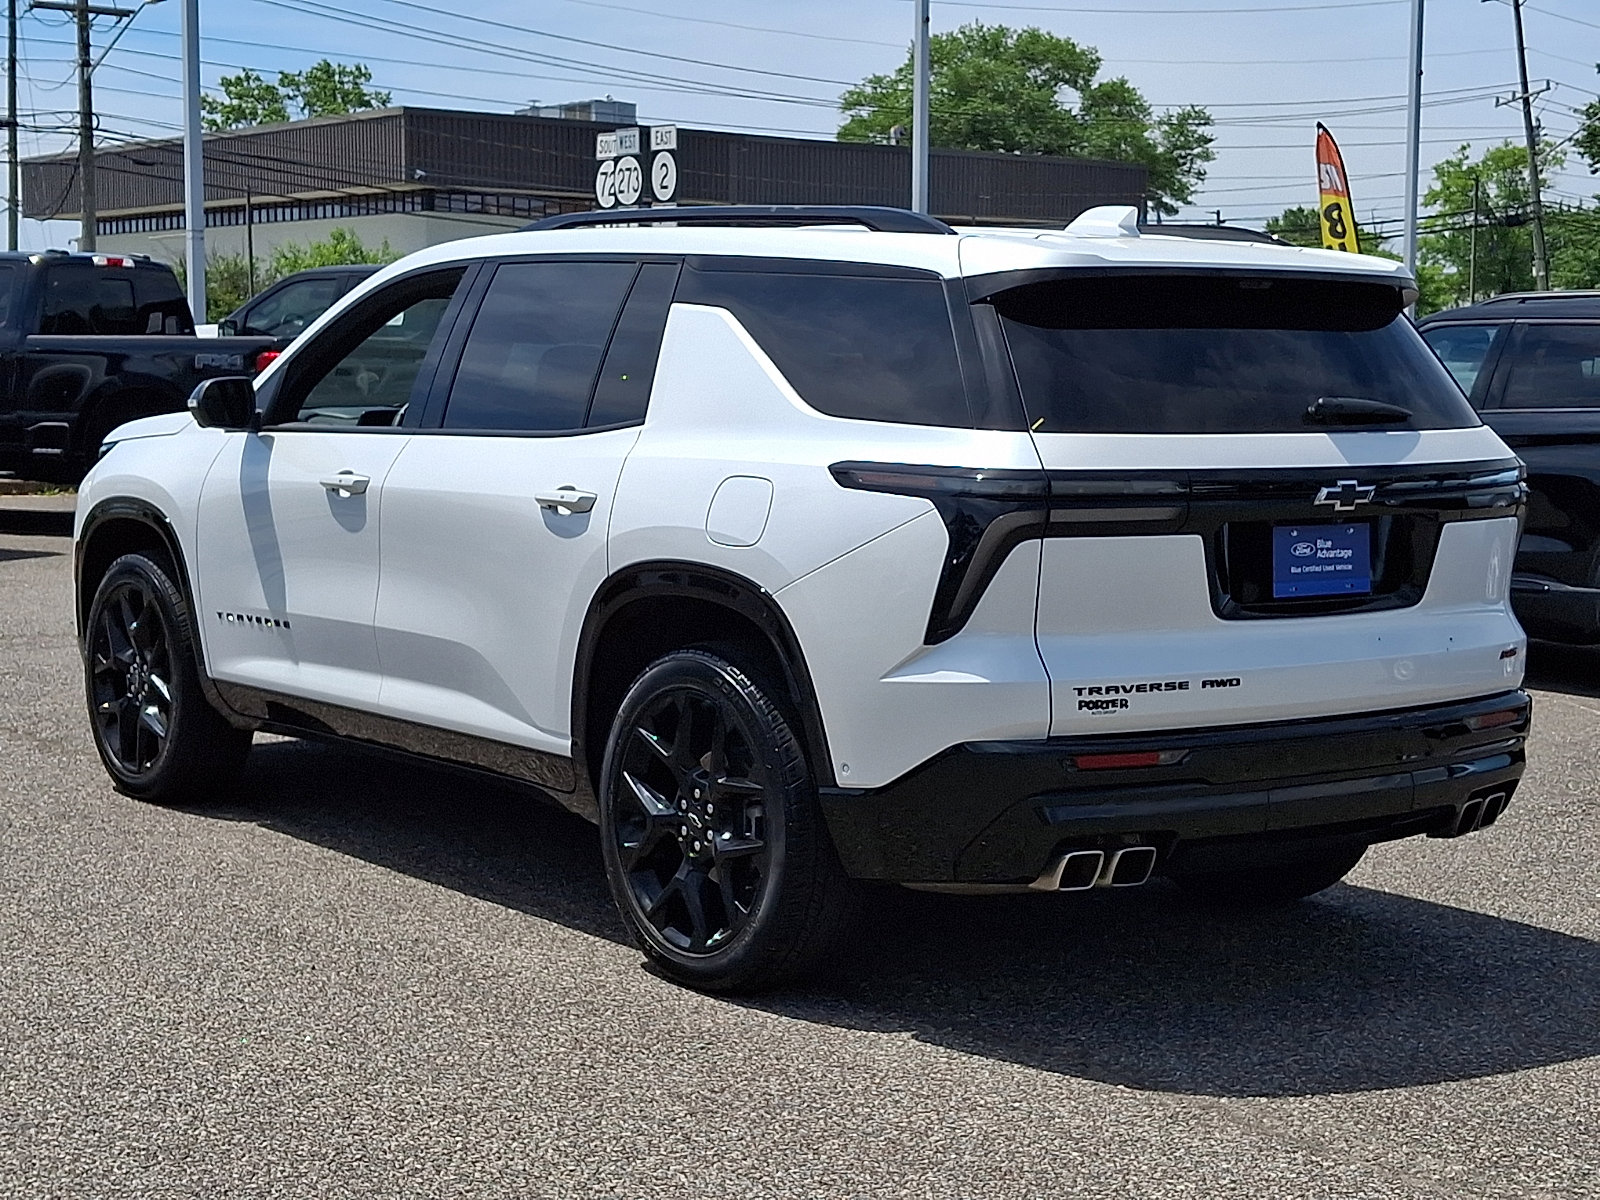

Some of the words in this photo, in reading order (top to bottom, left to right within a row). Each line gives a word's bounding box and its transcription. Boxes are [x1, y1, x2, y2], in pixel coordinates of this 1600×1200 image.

[619, 134, 636, 149] WEST
[655, 130, 672, 146] EAST
[599, 139, 617, 154] SOUT
[618, 166, 640, 194] 273
[659, 163, 669, 190] 2
[600, 172, 615, 197] 72
[1316, 538, 1332, 548] Blue
[1316, 549, 1353, 559] Advantage
[1072, 680, 1190, 696] TRAVERSE
[1201, 677, 1241, 689] AWD
[1077, 698, 1129, 711] PORTER
